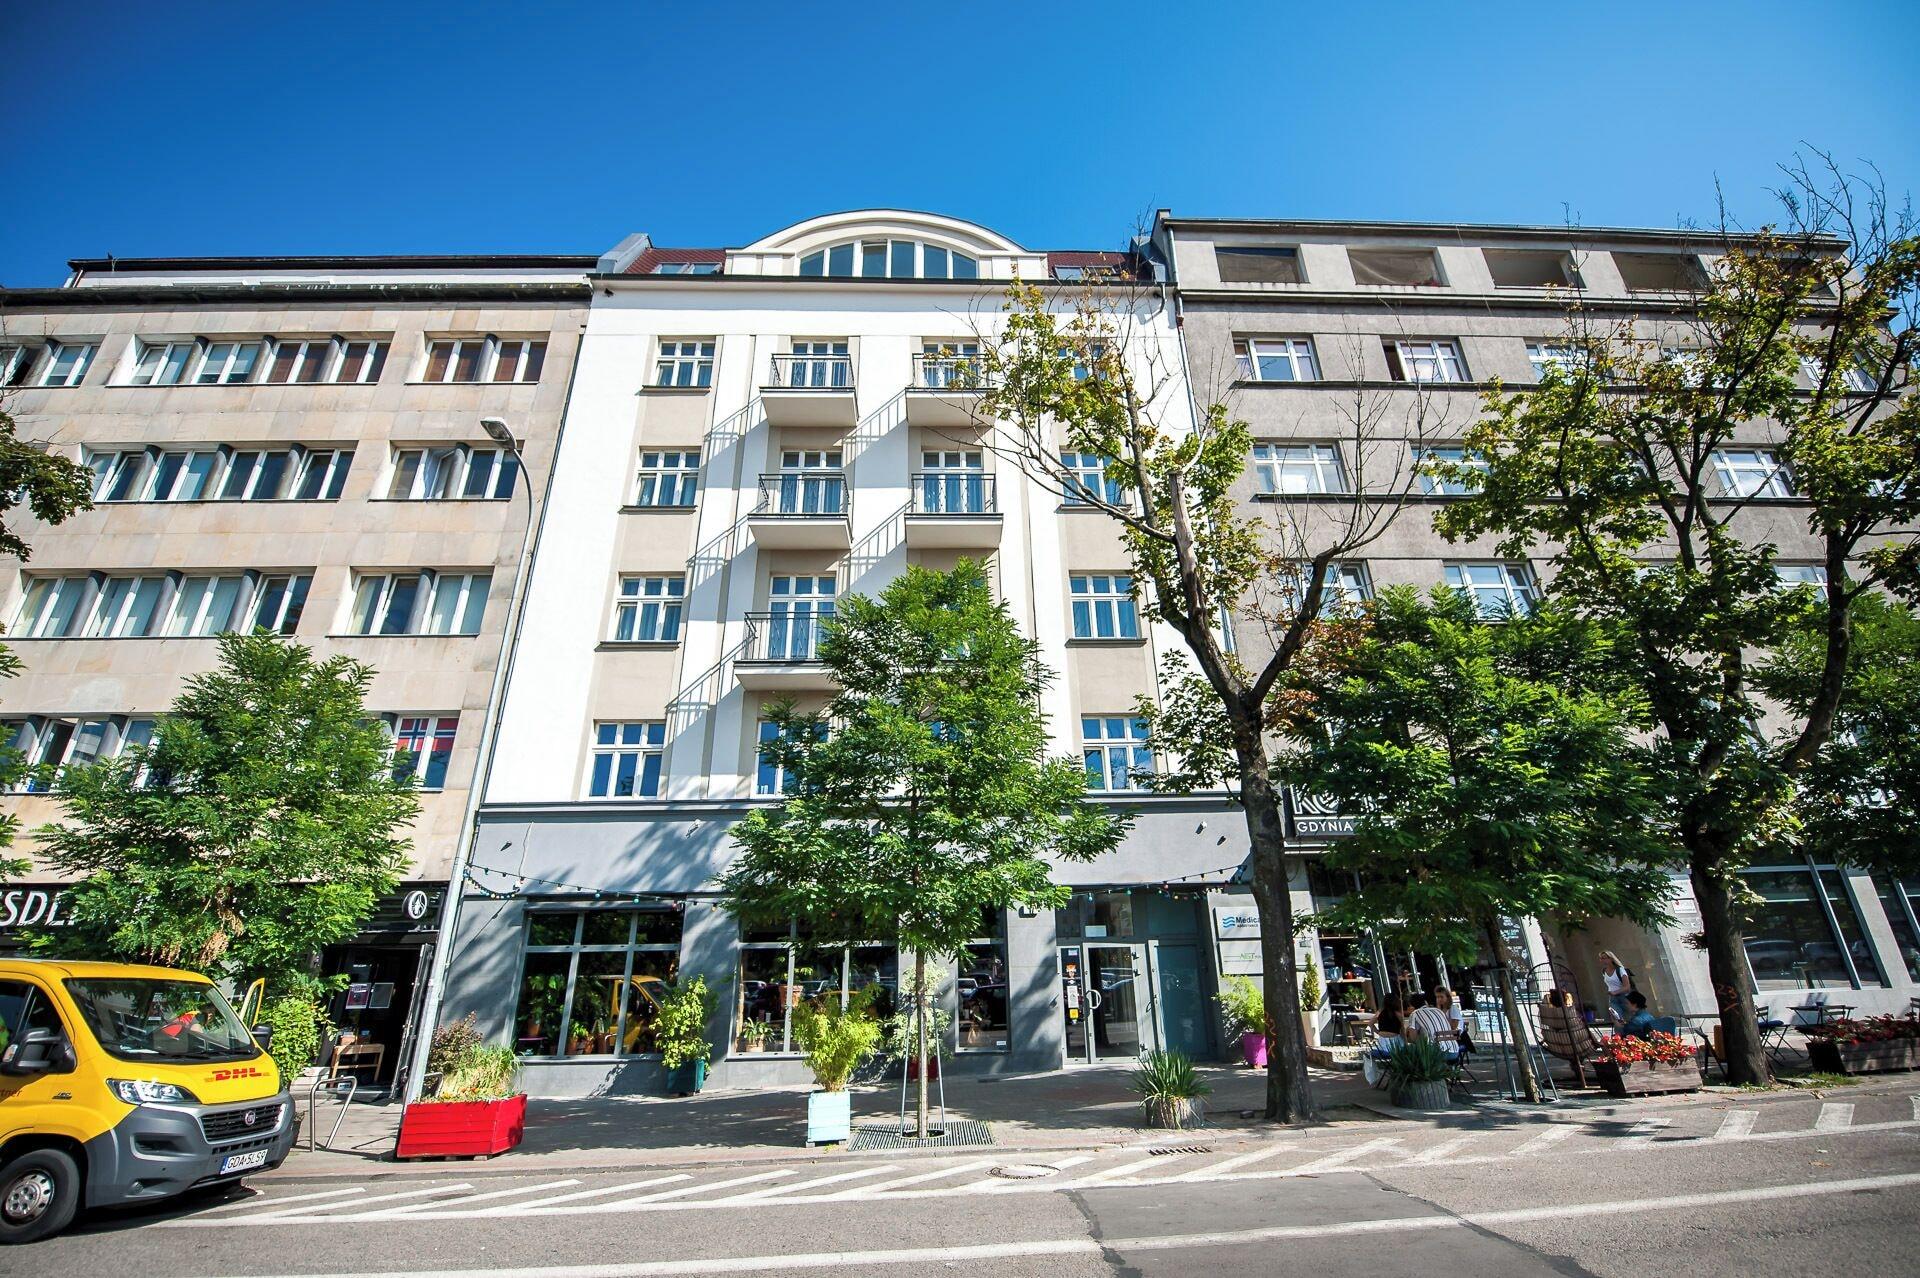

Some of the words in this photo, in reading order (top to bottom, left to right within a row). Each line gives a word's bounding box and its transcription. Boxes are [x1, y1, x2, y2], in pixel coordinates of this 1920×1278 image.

[1296, 821, 1353, 832] GDYNIA
[212, 1067, 262, 1081] DHL
[228, 1155, 244, 1168] GDA
